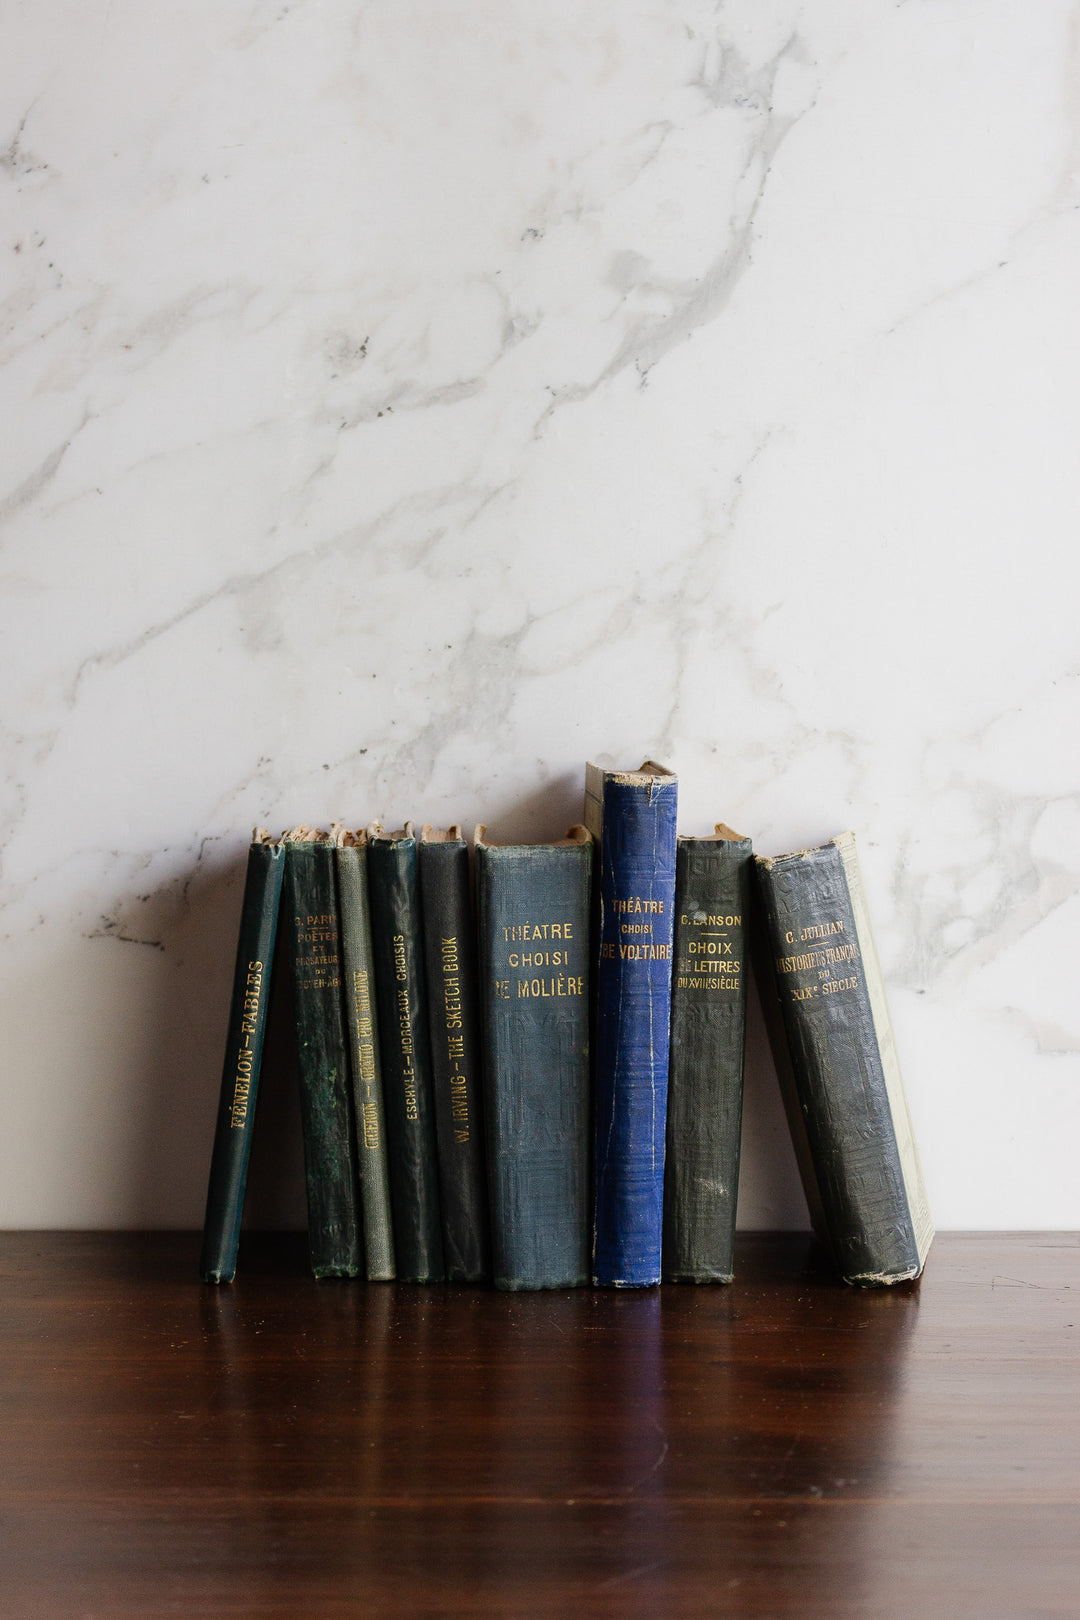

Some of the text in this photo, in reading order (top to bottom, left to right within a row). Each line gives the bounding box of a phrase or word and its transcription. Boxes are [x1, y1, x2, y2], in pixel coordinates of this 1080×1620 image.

[612, 896, 665, 913] THÉÂTRE
[681, 914, 691, 925] G.
[502, 920, 574, 942] THÉATRE
[621, 924, 654, 934] CHOISI
[785, 920, 845, 944] C. JULLIAN
[441, 936, 459, 972] BOOK
[618, 943, 672, 960] VOLTAIRE
[688, 942, 732, 955] CHOIX
[393, 935, 407, 981] CHOISIS
[508, 950, 568, 968] CHOISI
[694, 960, 740, 973] LETTRES
[710, 975, 740, 990] SIÈCLE
[818, 969, 830, 980] DU
[518, 972, 584, 999] MOLIÈRE
[821, 976, 858, 995] SIÈCLE
[444, 977, 463, 1029] SKETCH
[447, 1035, 465, 1060] THE
[450, 1075, 469, 1122] IRVING
